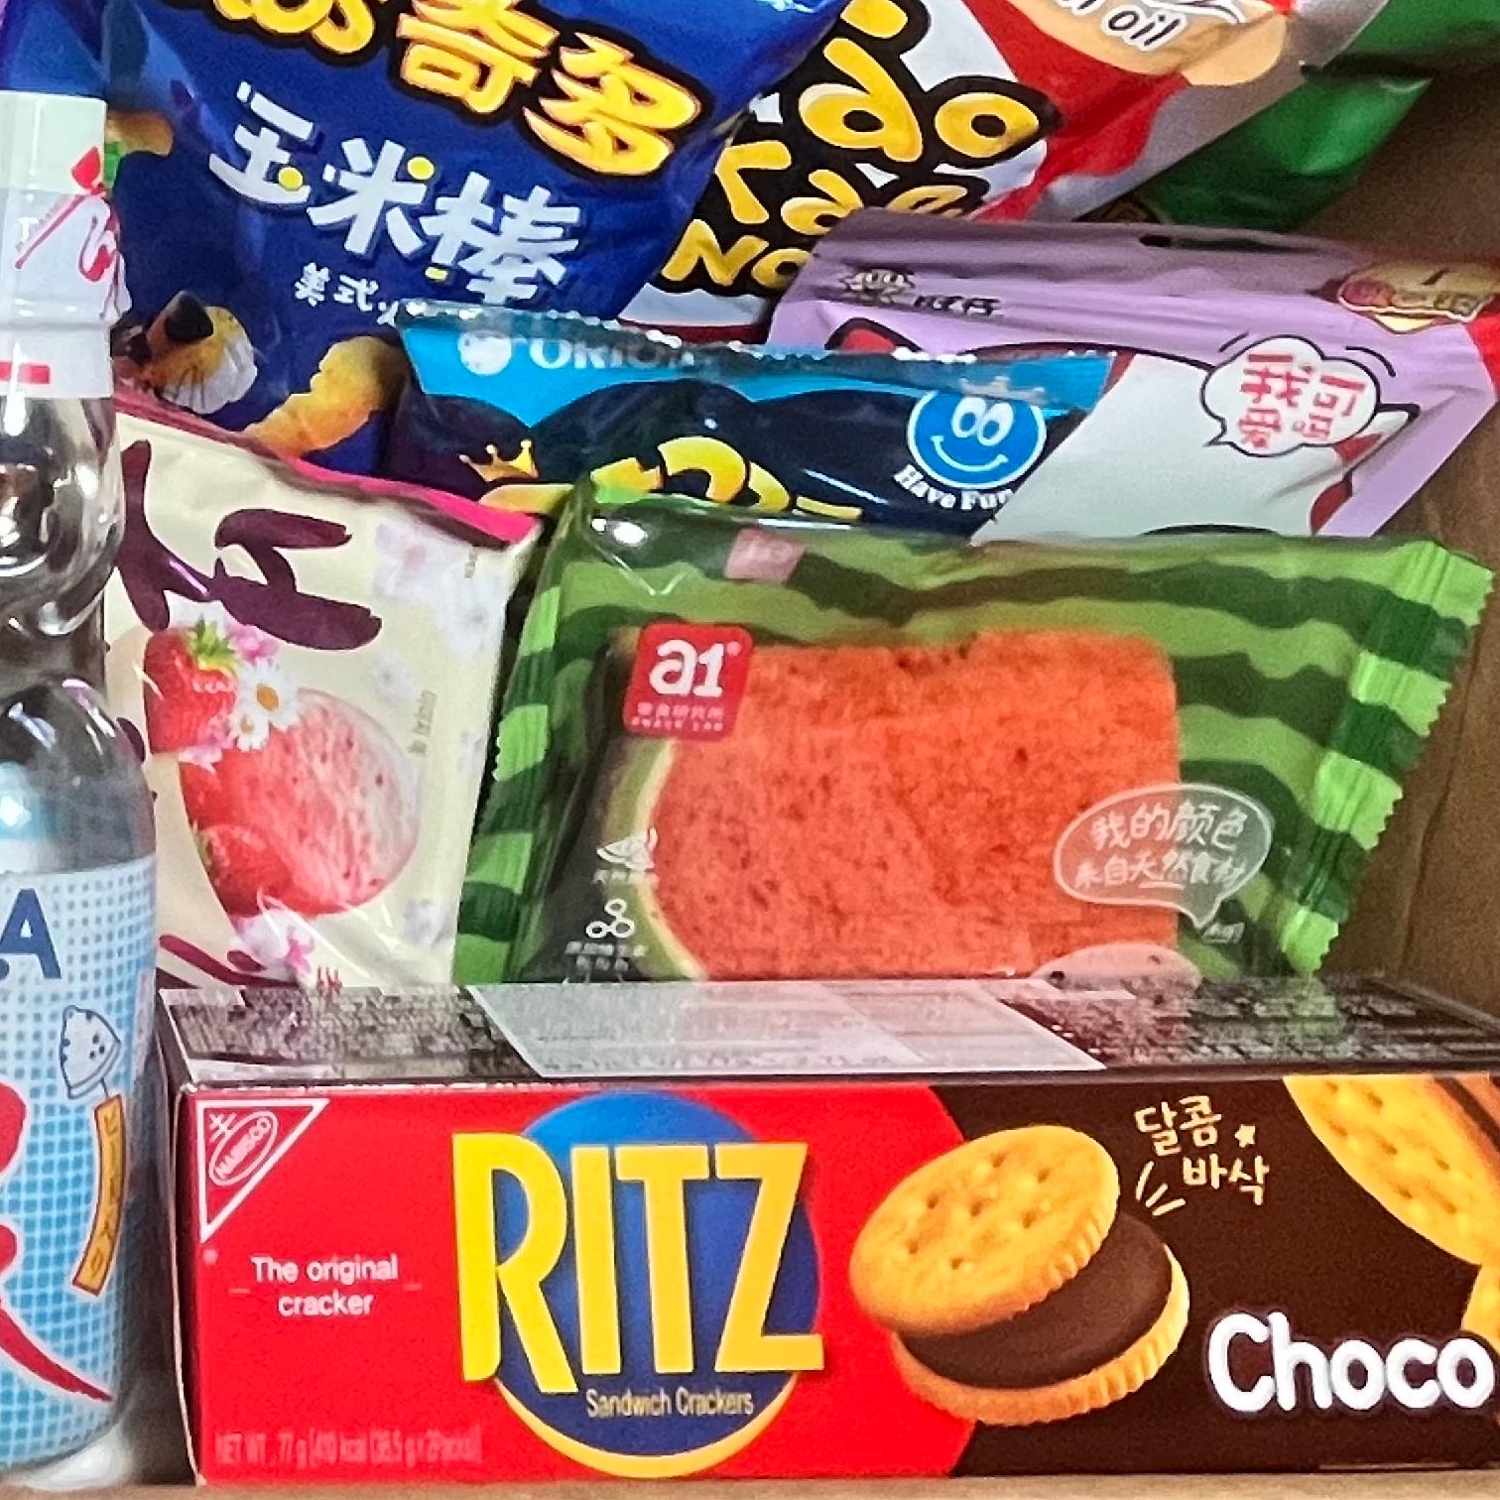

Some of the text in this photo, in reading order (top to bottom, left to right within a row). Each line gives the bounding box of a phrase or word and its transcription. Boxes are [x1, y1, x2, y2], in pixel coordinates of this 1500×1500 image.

[1104, 4, 1188, 53] oil
[209, 82, 588, 306] 玉米棒
[1091, 799, 1248, 852] 我的颜色
[1074, 848, 1247, 890] 来自天然食材
[1133, 1095, 1223, 1158] 달콤
[1182, 1155, 1271, 1206] 바삭
[250, 1252, 399, 1286] The original
[452, 1130, 825, 1396] RITZ
[278, 1288, 376, 1318] cracker
[1207, 1310, 1495, 1414] Choco
[585, 1384, 756, 1419] Sandwich Crackers
